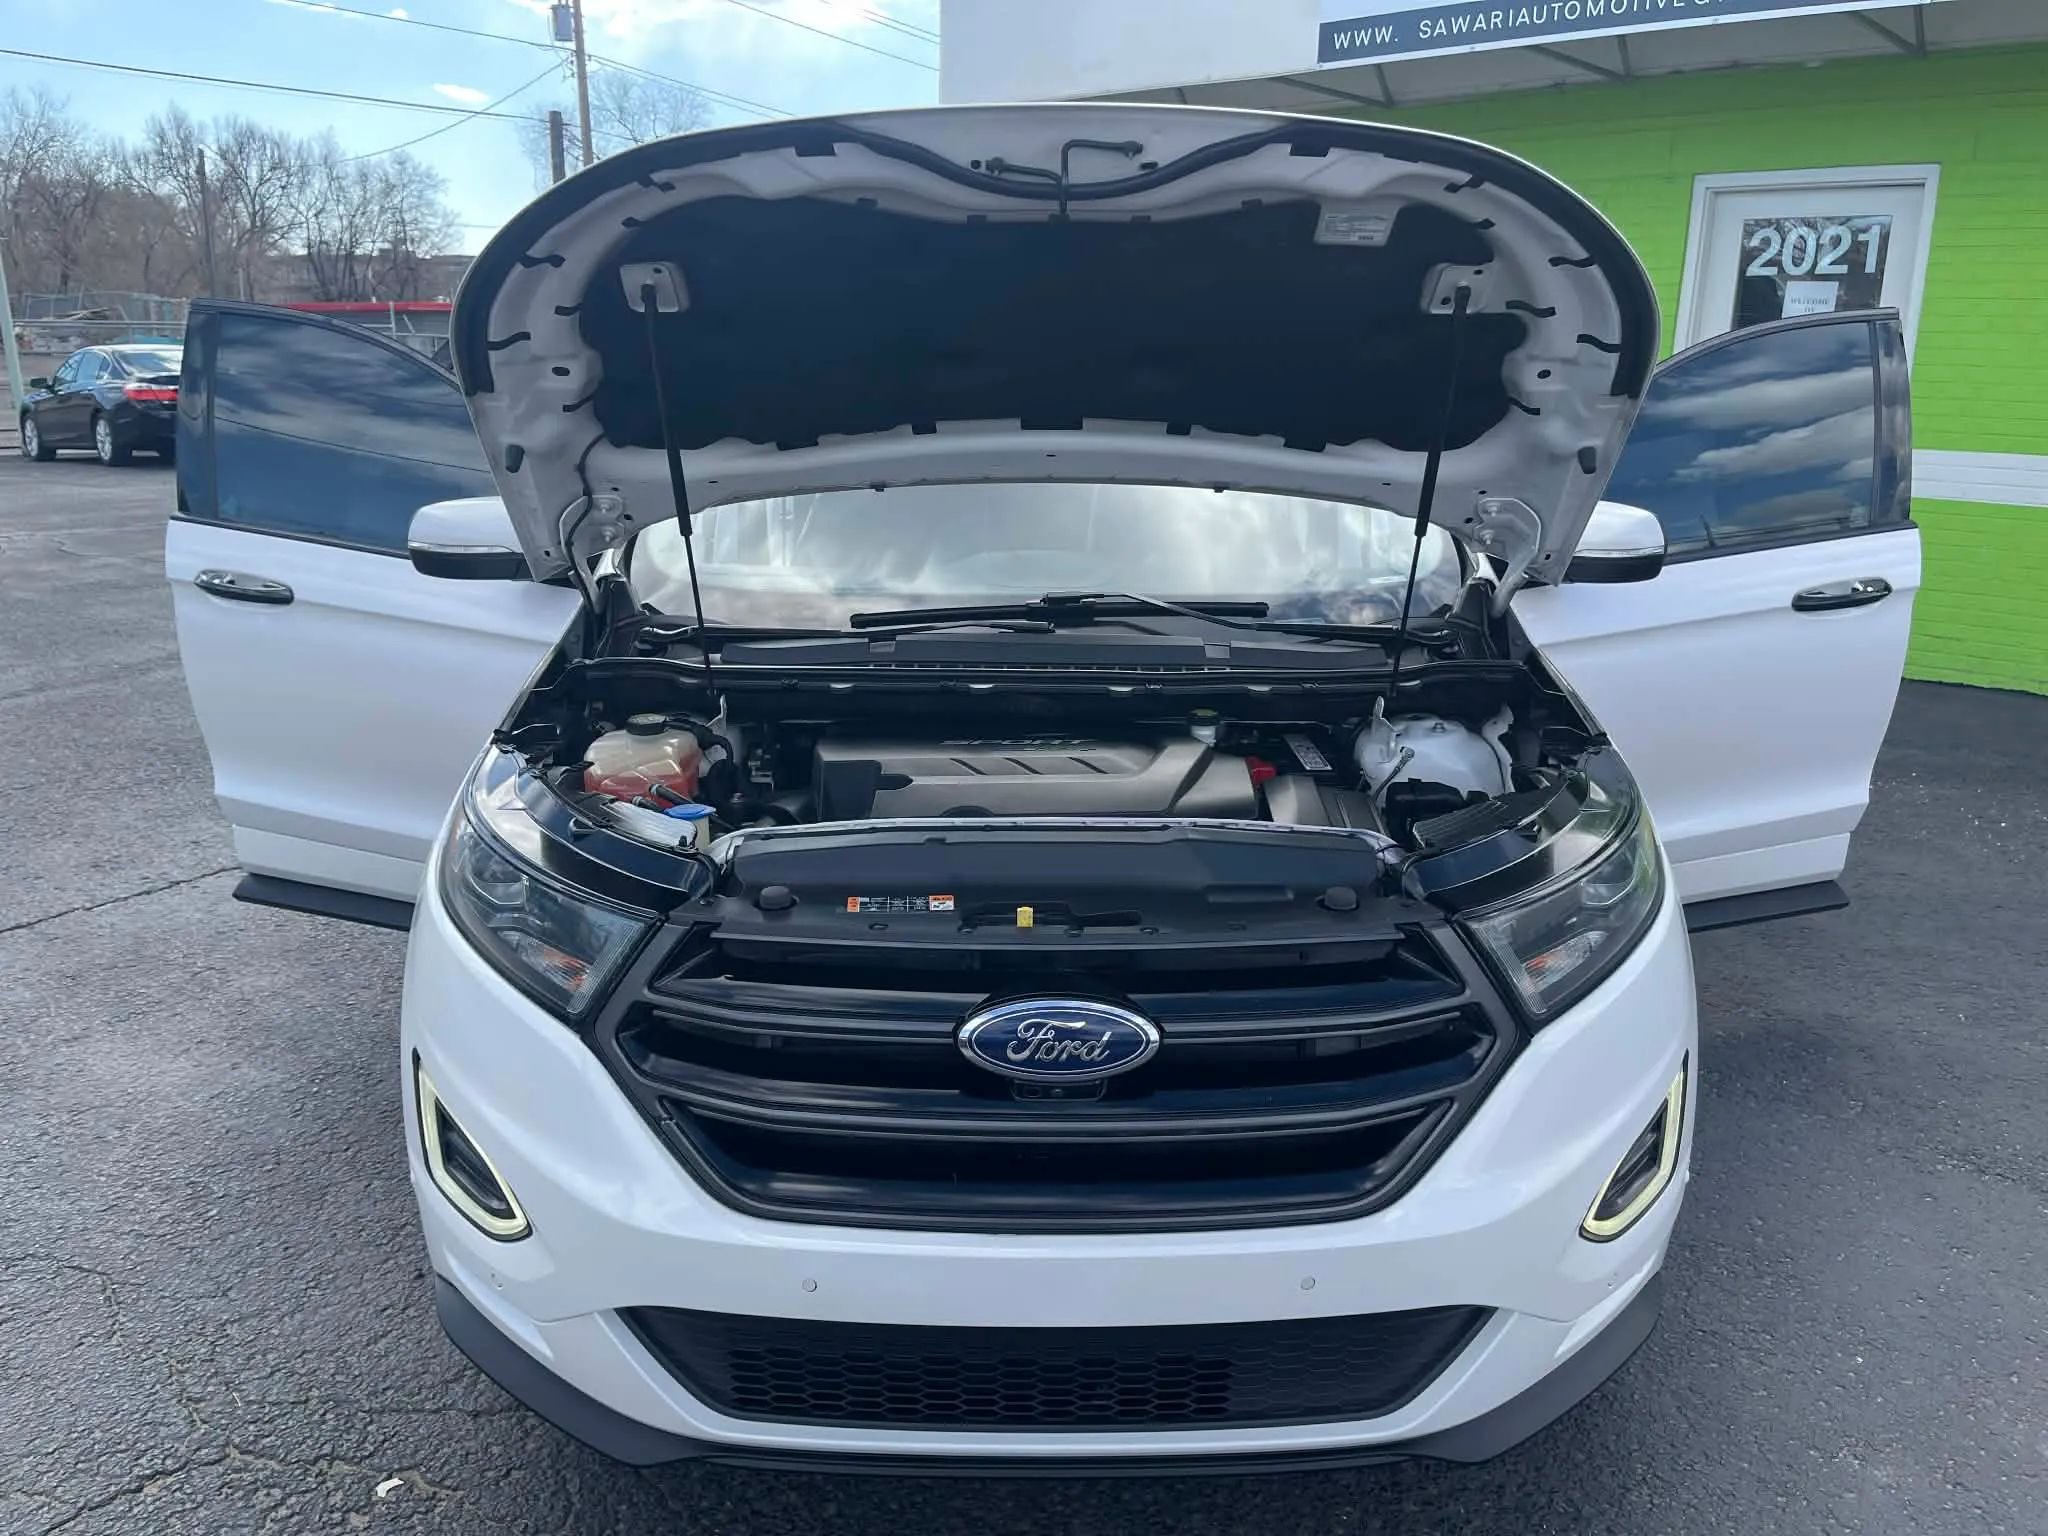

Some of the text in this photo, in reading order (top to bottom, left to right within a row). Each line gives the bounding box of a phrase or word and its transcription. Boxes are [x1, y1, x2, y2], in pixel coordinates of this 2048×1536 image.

[1334, 25, 1399, 50] WWW.
[1745, 224, 1881, 277] 2021
[1007, 1018, 1112, 1061] Ford
